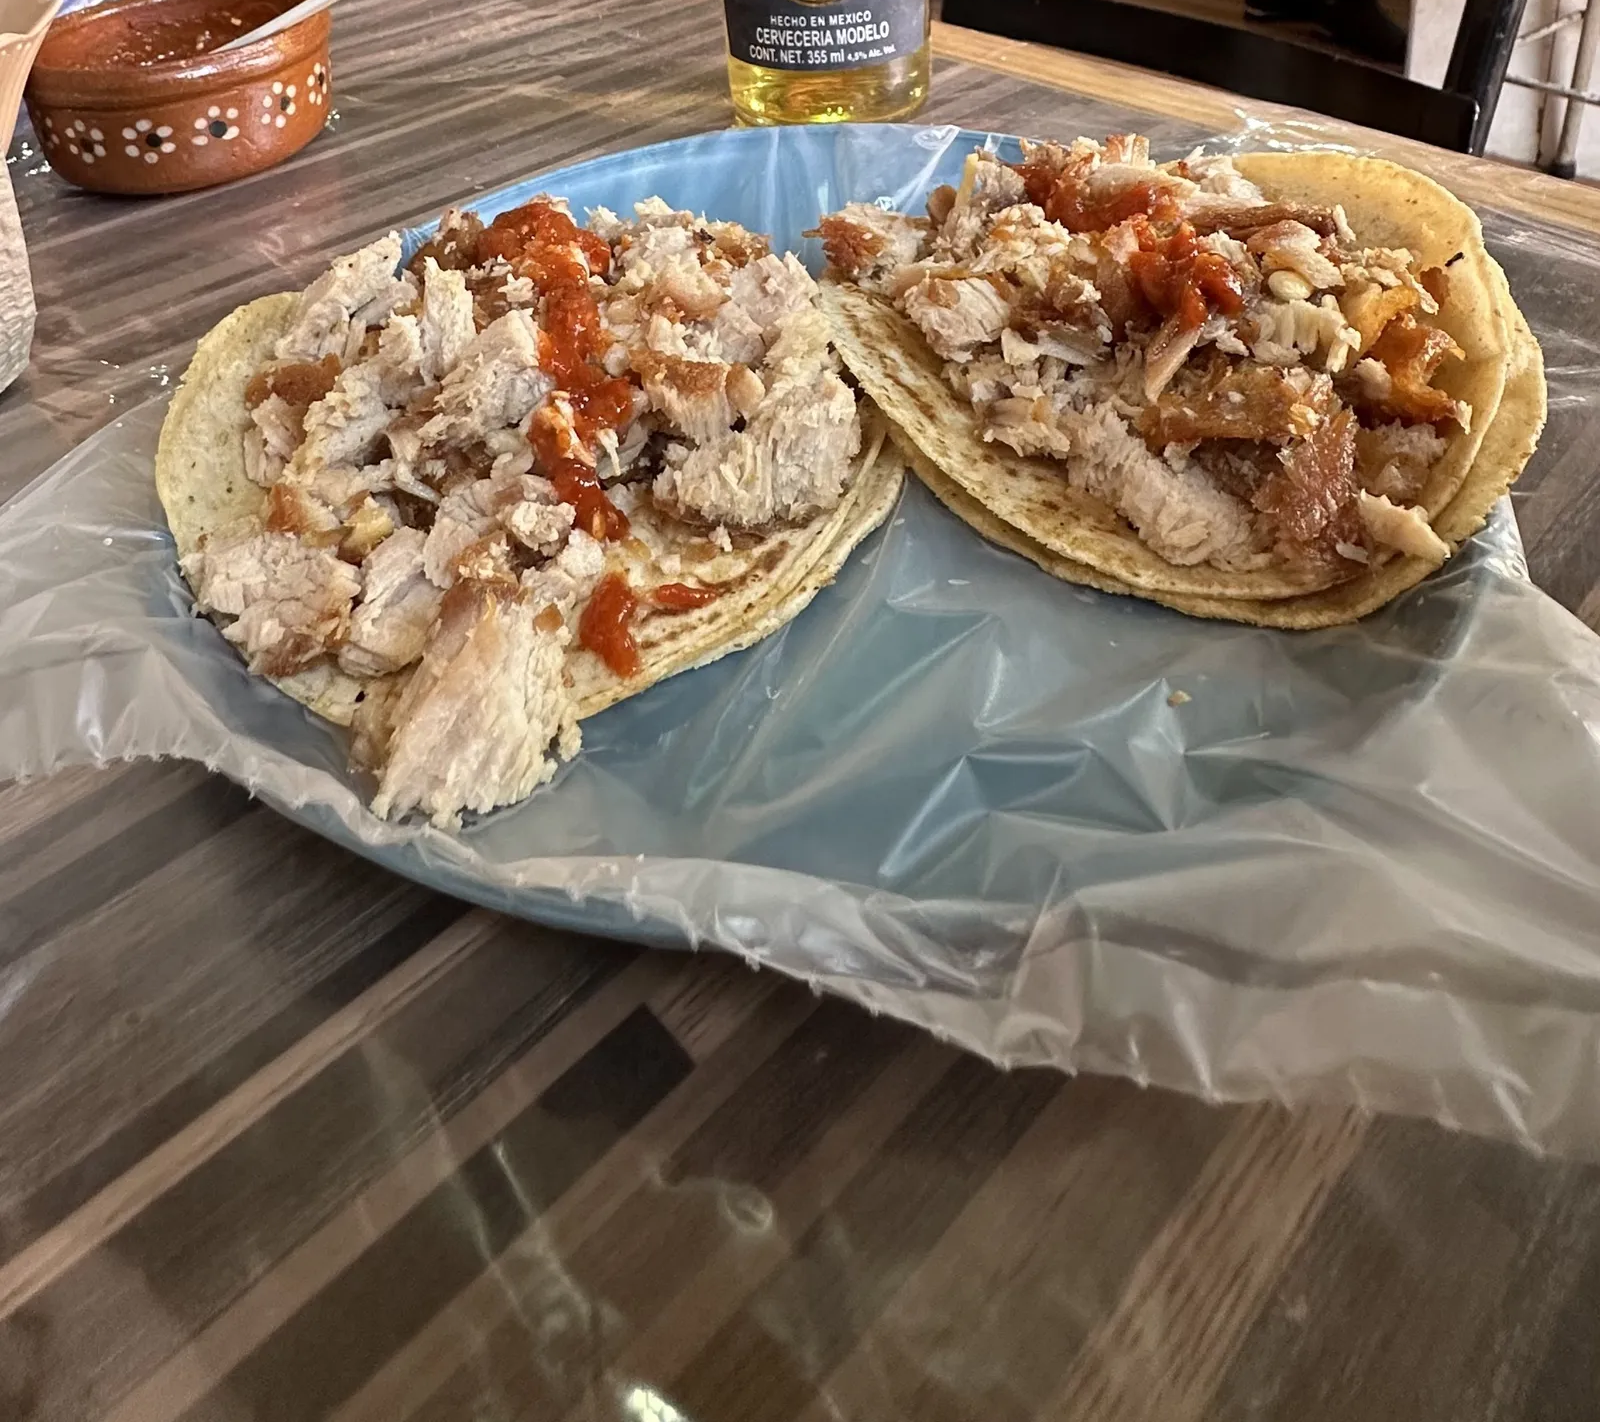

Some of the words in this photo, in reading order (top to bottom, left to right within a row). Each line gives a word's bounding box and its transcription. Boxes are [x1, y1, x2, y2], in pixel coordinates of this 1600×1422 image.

[770, 15, 807, 27] HECHO
[810, 16, 825, 27] EN
[829, 10, 871, 26] MEXICO
[756, 27, 833, 47] CERVECERIA
[836, 21, 890, 45] MODELO
[749, 45, 778, 62] CONT.
[780, 49, 804, 64] NET.
[807, 50, 827, 64] 355
[830, 49, 844, 62] ml
